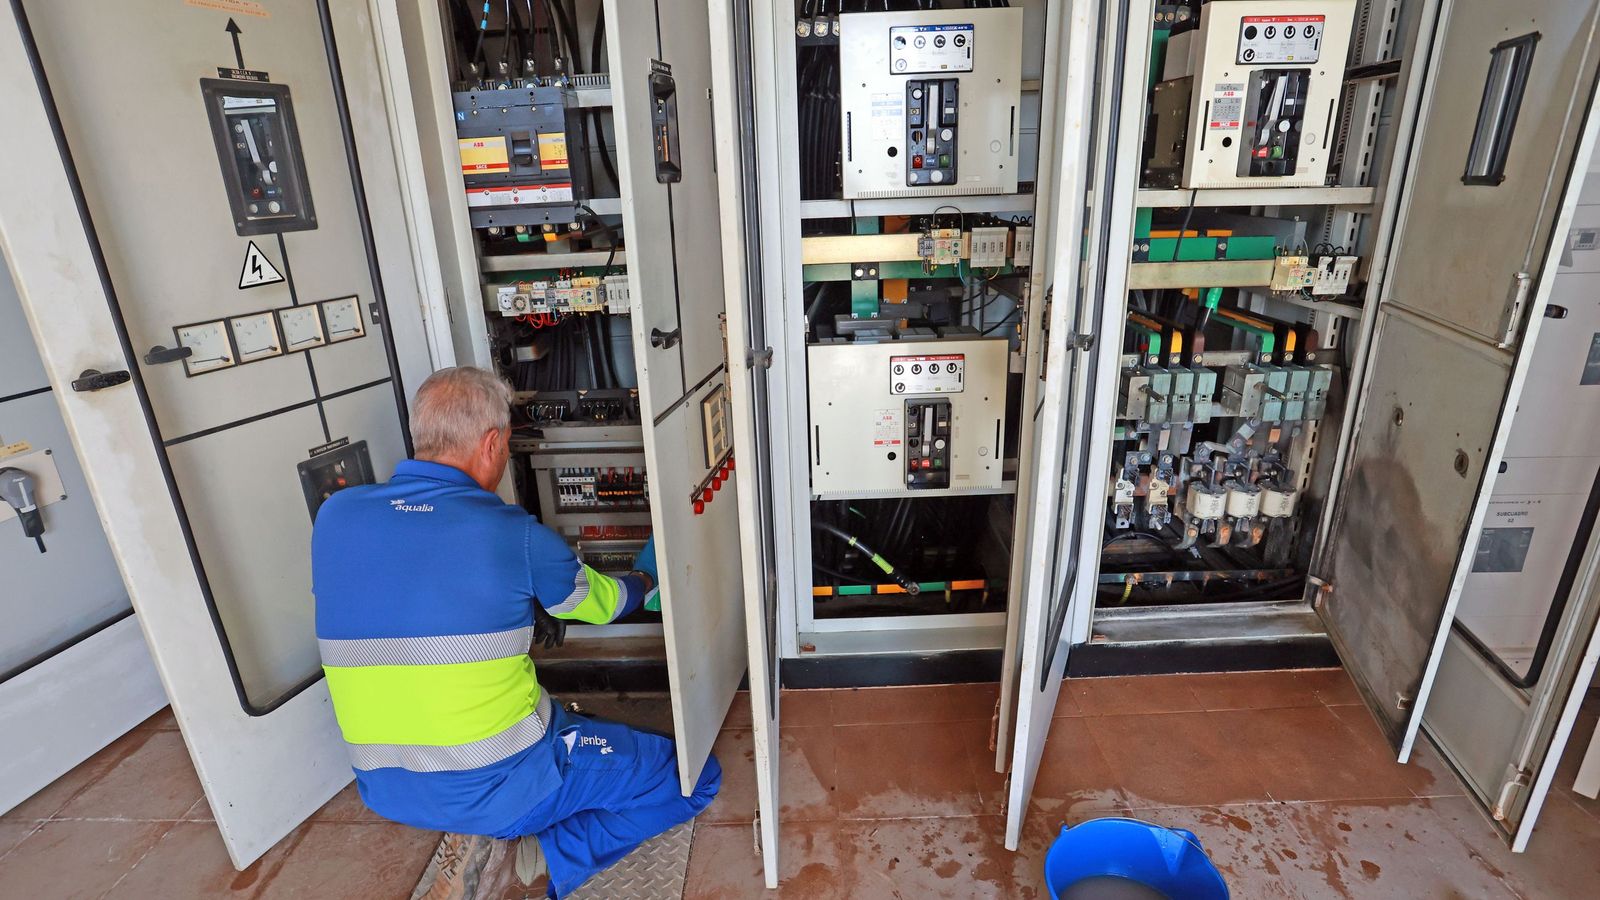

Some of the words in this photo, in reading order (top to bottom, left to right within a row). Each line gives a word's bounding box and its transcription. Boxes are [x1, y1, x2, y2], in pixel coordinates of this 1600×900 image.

[457, 112, 465, 120] N
[395, 504, 434, 513] aqualia
[578, 735, 607, 747] aqual
